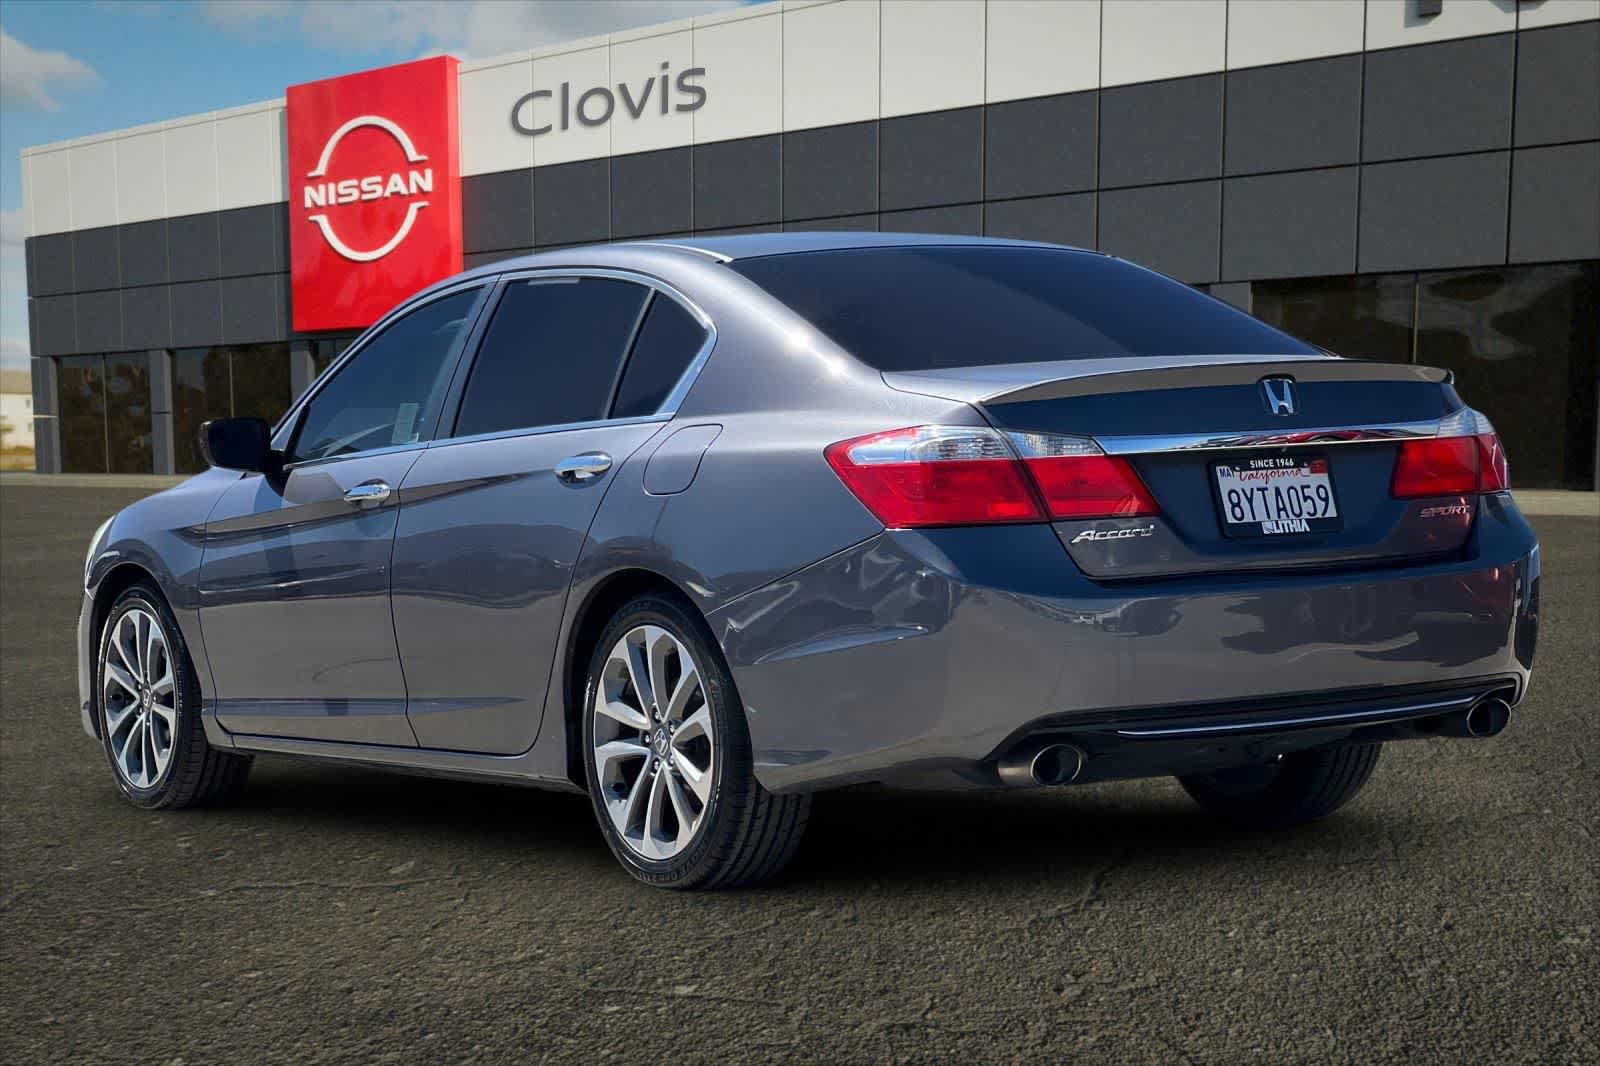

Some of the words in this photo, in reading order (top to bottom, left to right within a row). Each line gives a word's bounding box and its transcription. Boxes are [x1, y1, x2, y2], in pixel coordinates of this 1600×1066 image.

[511, 62, 707, 137] Clovis
[304, 168, 433, 208] NISSAN
[1250, 458, 1274, 469] SINCE
[1275, 457, 1294, 467] 1946
[1239, 466, 1310, 485] California
[1227, 484, 1330, 522] 8YTA059
[1420, 505, 1470, 518] SPORT
[1071, 524, 1154, 543] Accord
[1272, 519, 1311, 534] LITHIA
